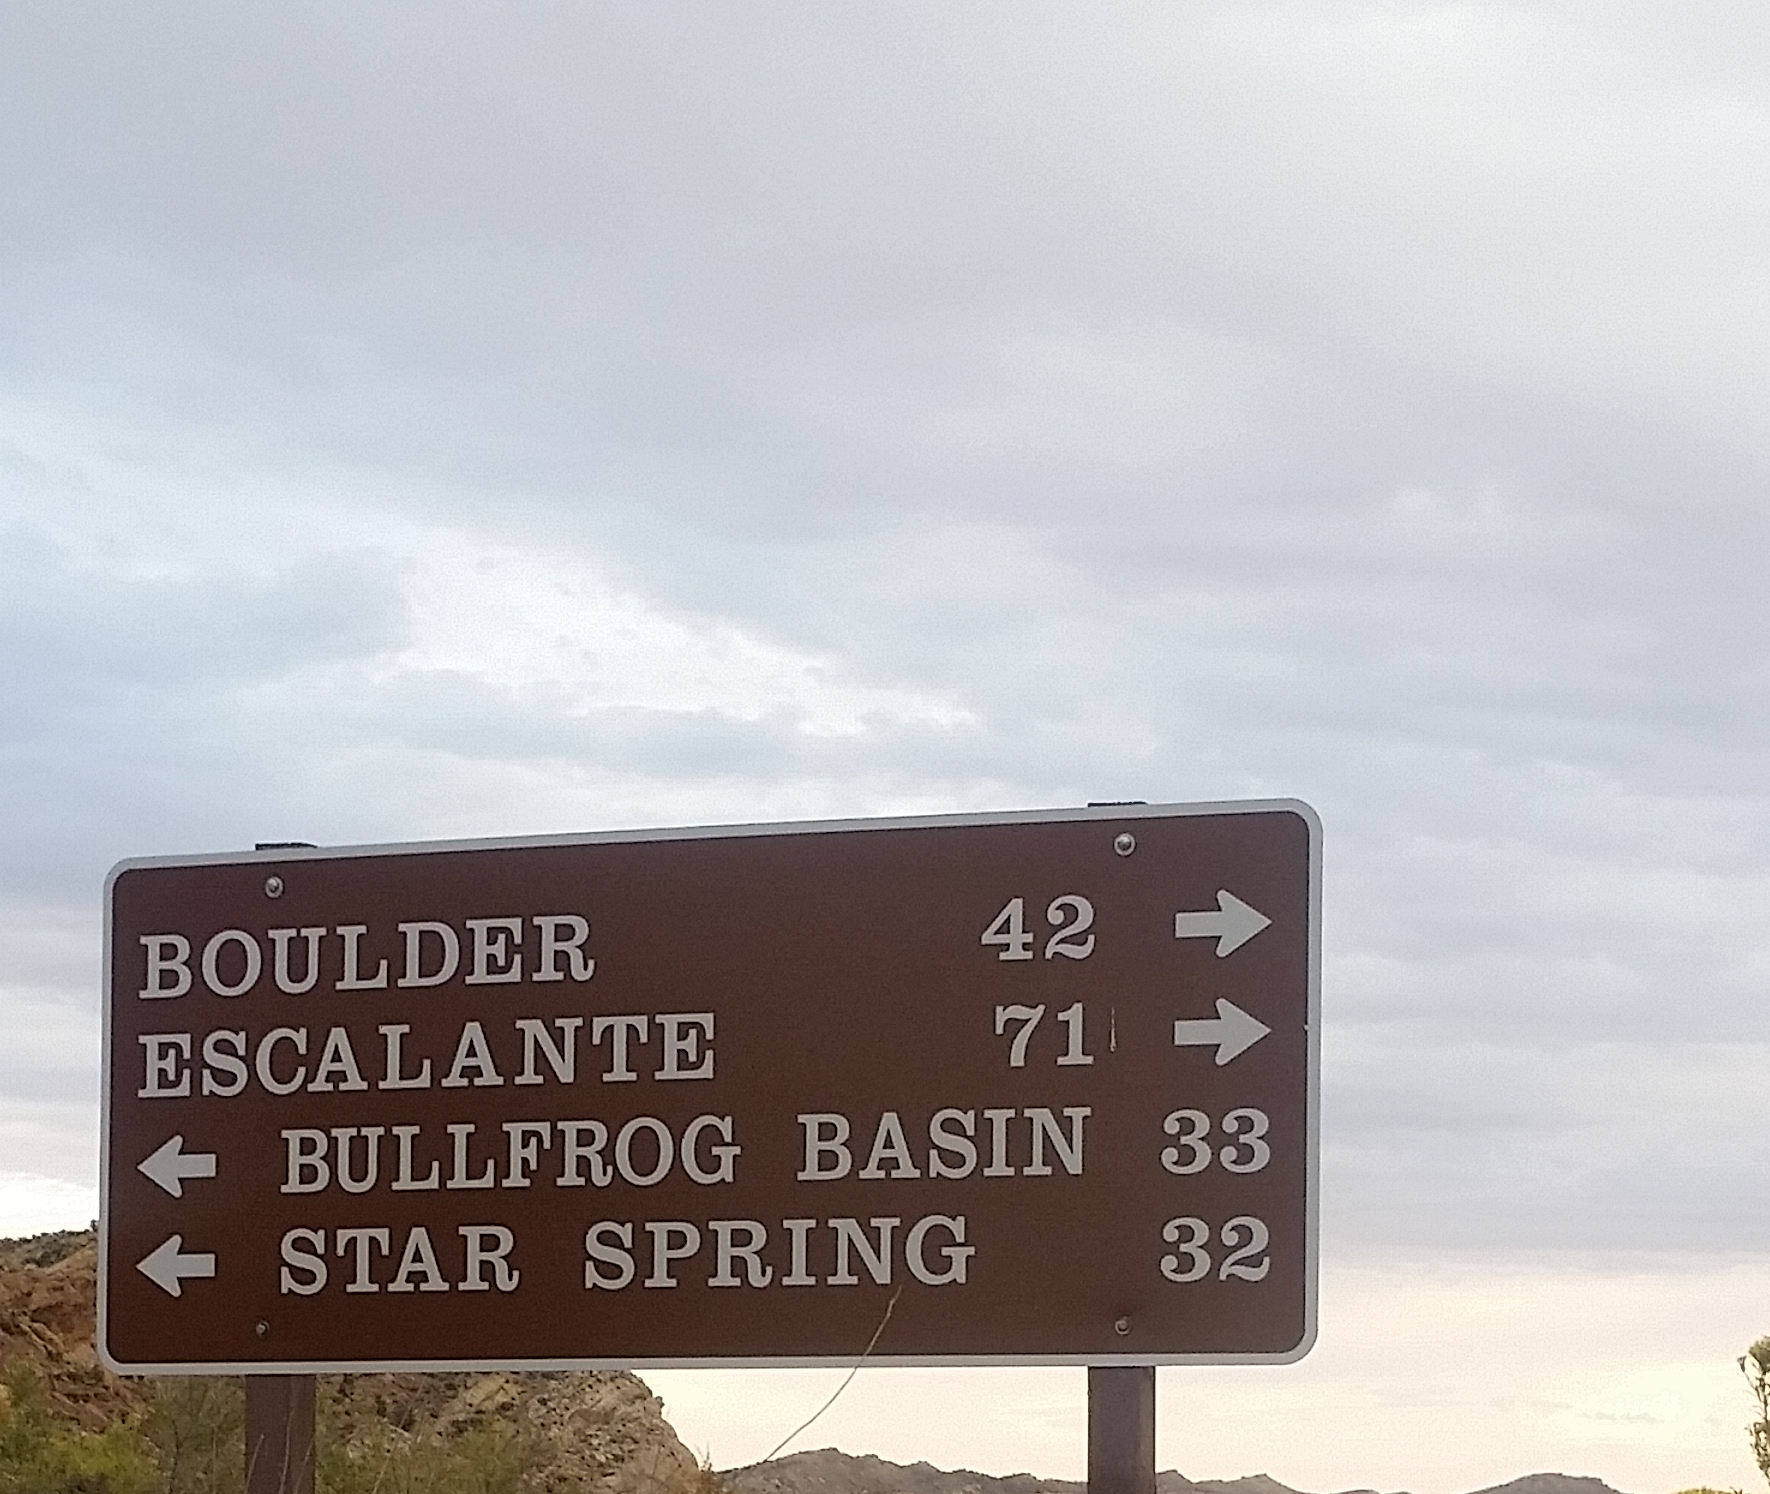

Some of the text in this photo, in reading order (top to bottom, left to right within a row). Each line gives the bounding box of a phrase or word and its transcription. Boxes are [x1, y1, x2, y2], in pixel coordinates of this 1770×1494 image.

[139, 895, 1097, 999] BOULDER 42
[137, 1002, 1095, 1098] ESCALANTE 71
[280, 1106, 1271, 1194] BULLFROG BASIN 33
[279, 1213, 1271, 1296] STAR SPRING 32
